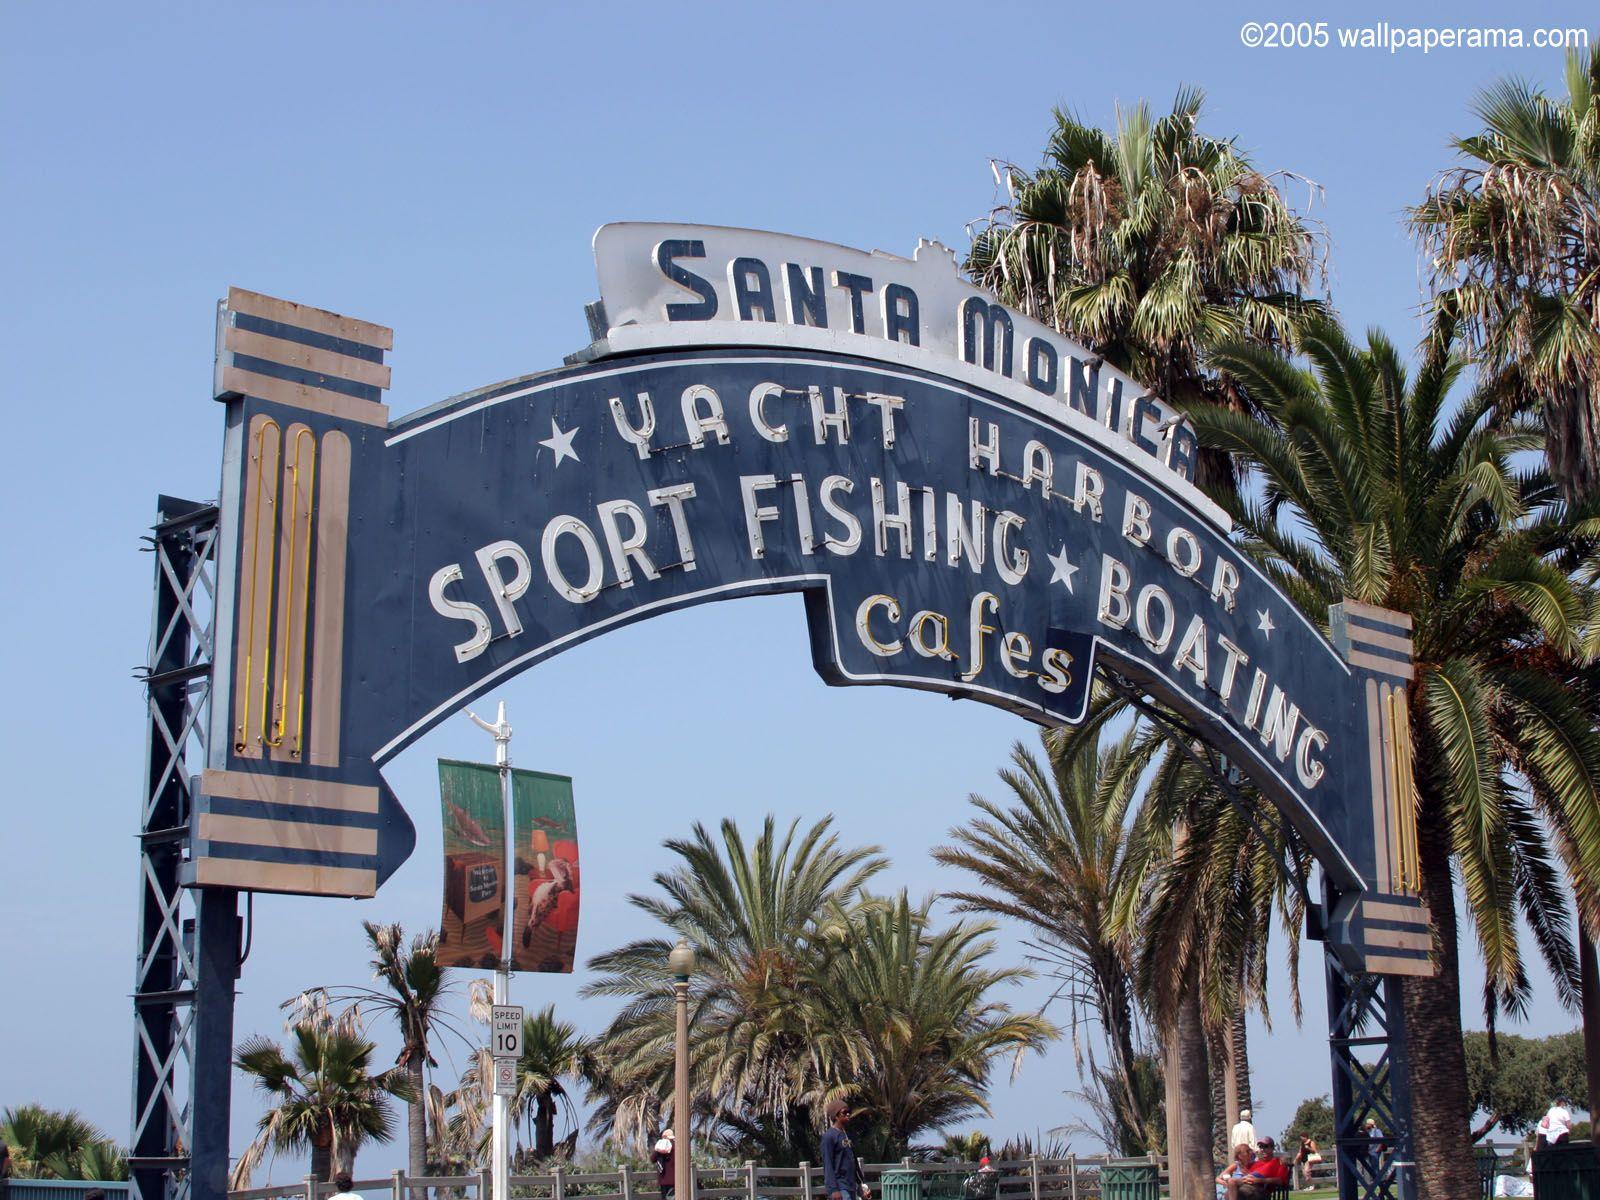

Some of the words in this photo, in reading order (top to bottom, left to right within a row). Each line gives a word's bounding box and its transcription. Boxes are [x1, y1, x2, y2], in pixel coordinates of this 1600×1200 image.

[652, 239, 920, 347] SANTA
[958, 296, 1198, 485] MONICA
[609, 382, 905, 460] YACHT
[969, 417, 1240, 614] HARBOR
[428, 483, 697, 663] SPORT
[740, 473, 1031, 585] FISHING
[1097, 553, 1329, 789] BOATING
[494, 1011, 521, 1020] SPEED
[497, 1034, 517, 1051] 10
